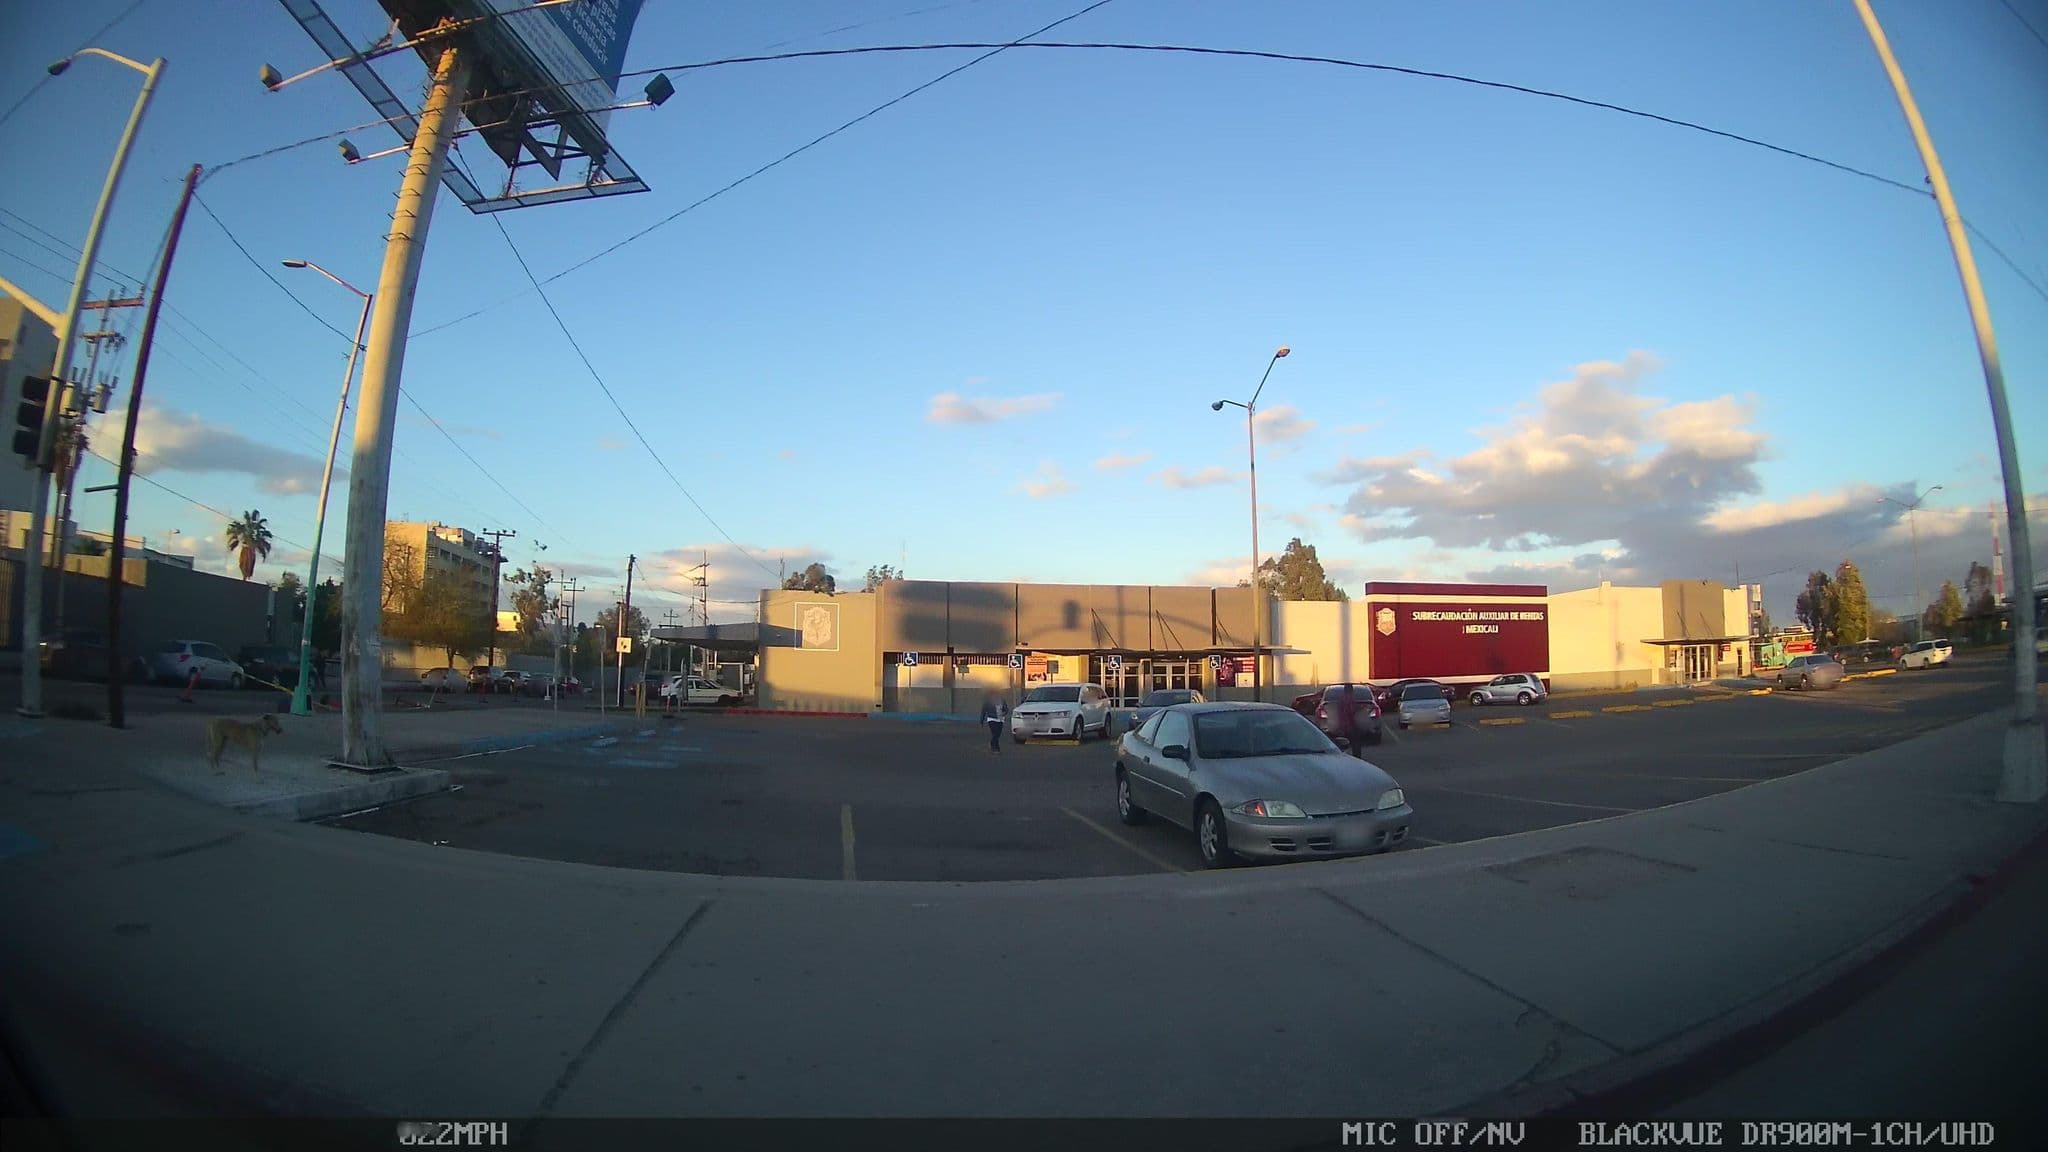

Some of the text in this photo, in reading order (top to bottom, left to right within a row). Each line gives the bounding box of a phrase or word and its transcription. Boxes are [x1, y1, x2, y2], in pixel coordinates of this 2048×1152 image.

[576, 2, 607, 48] licencia
[590, 5, 617, 41] placas
[572, 19, 608, 64] conducir
[1465, 624, 1498, 634] MEXICALI
[1479, 611, 1509, 620] AUXILIAR
[1510, 611, 1519, 620] DE
[1519, 611, 1544, 620] RENTAS
